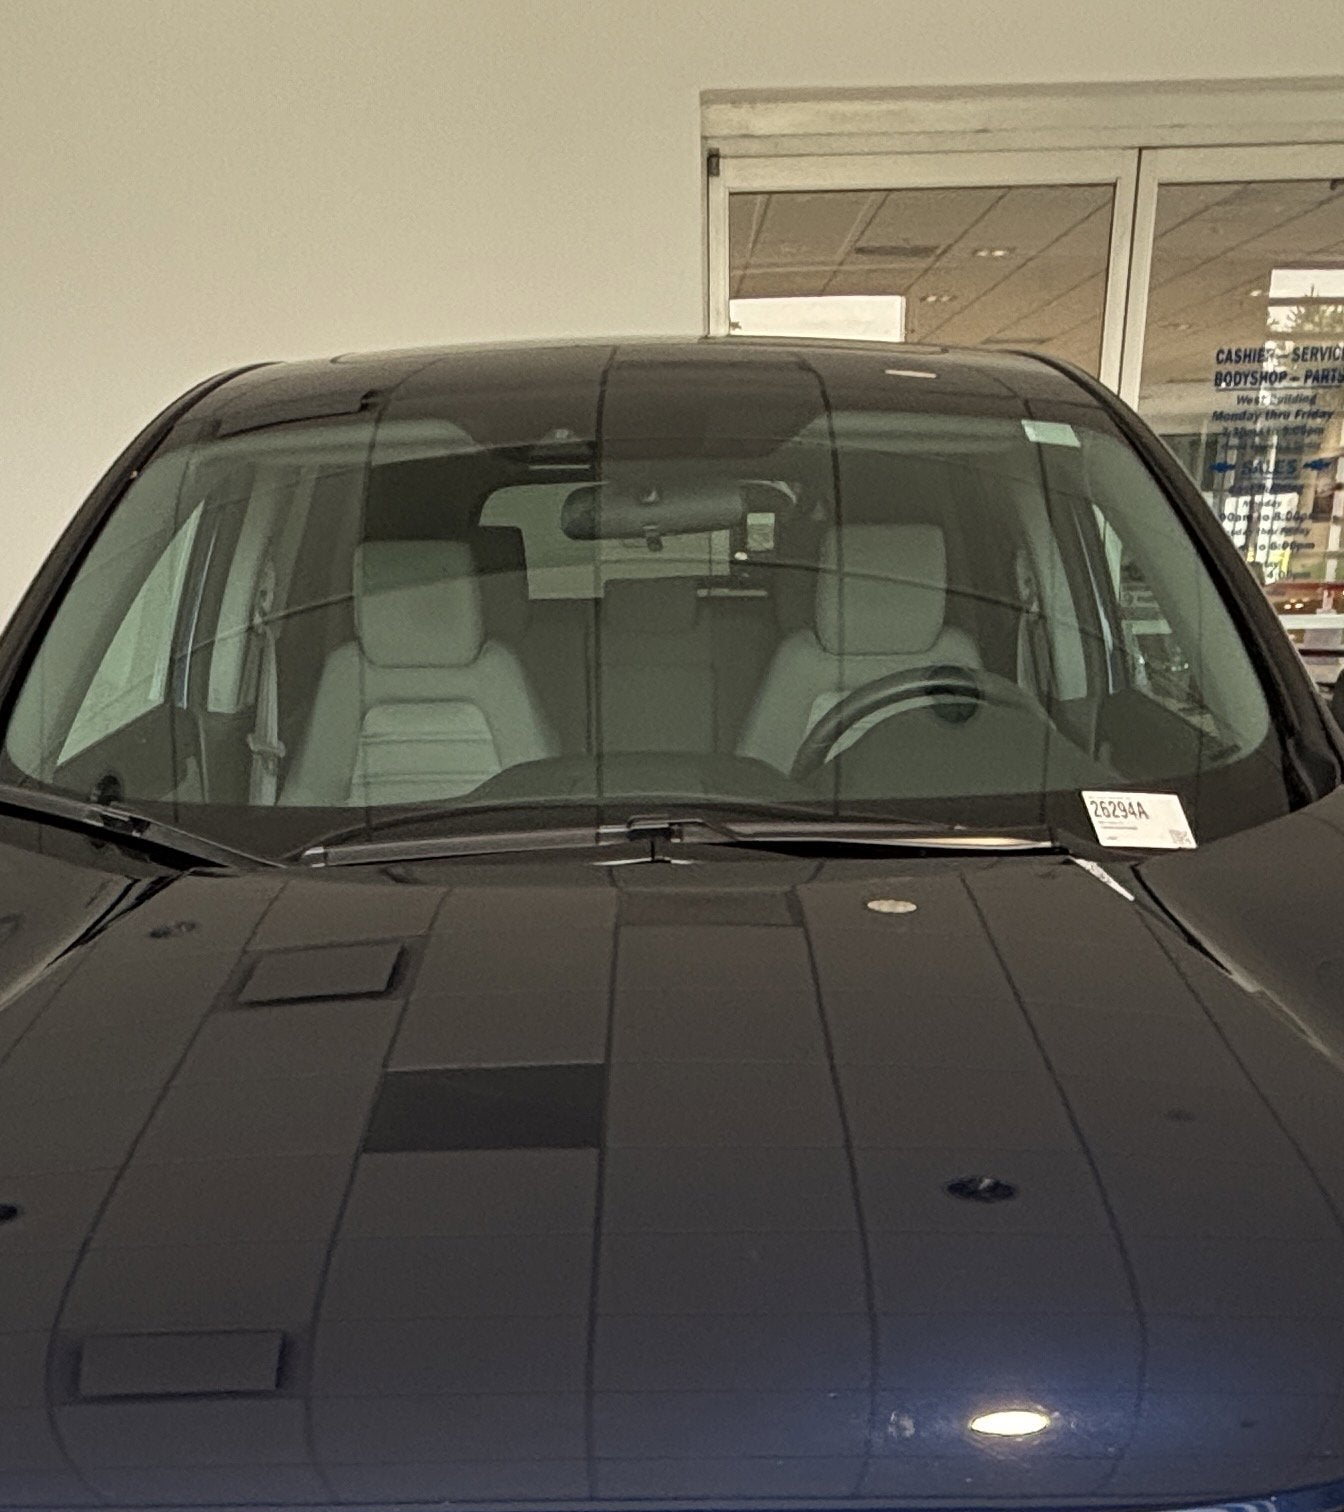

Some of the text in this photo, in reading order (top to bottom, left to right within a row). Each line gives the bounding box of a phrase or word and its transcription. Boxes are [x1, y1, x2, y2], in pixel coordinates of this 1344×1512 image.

[1214, 370, 1288, 387] BODYSHOP
[1212, 410, 1334, 424] Monday thru Friday
